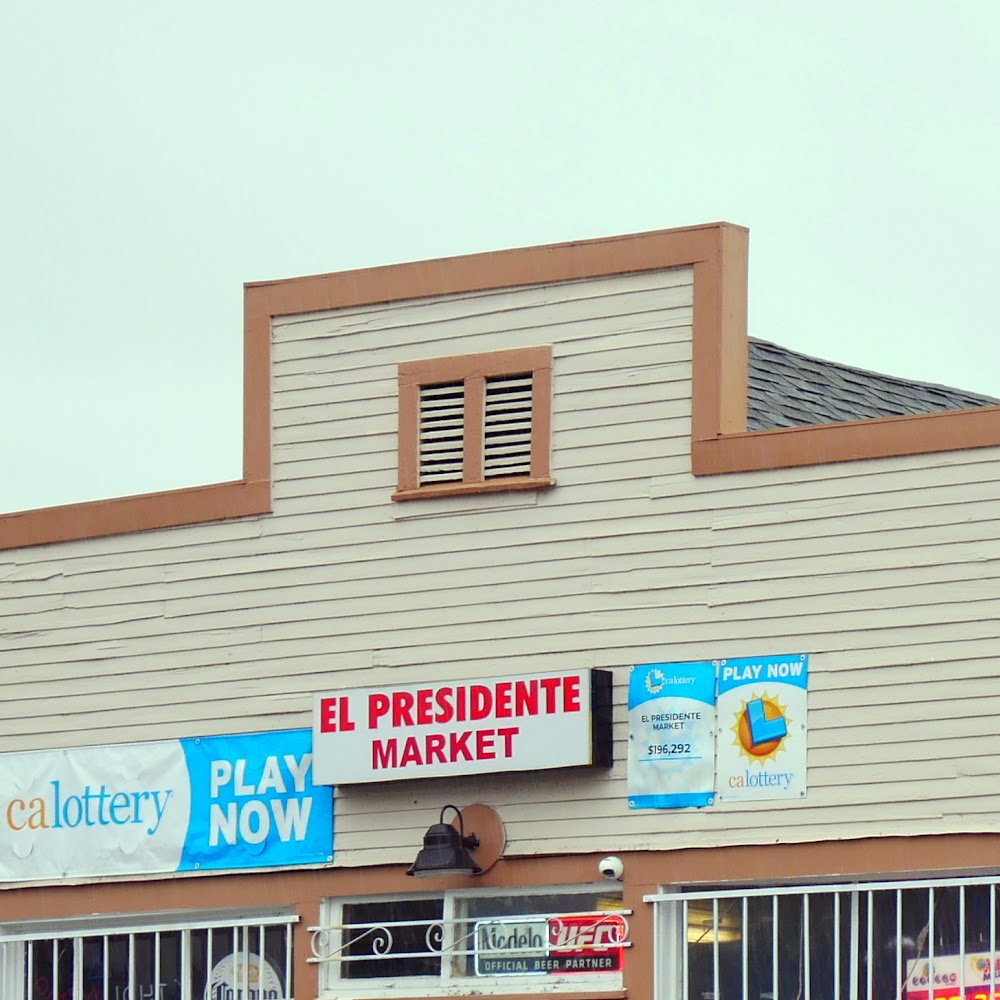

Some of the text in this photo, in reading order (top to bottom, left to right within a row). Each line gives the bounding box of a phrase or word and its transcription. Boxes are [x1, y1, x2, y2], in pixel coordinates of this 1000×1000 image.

[722, 661, 804, 681] PLAY NOW
[320, 676, 580, 733] EL PRESIDENTE
[641, 711, 702, 723] EL PRESIDENTE
[652, 721, 685, 731] MARKET
[372, 727, 519, 770] MARKET
[648, 743, 691, 756] $196,292
[209, 753, 312, 798] PLAY
[728, 769, 794, 790] calottery
[6, 780, 173, 836] calottery
[208, 796, 313, 847] NOW
[485, 957, 612, 971] OFFICIAL BEER PARTNER
